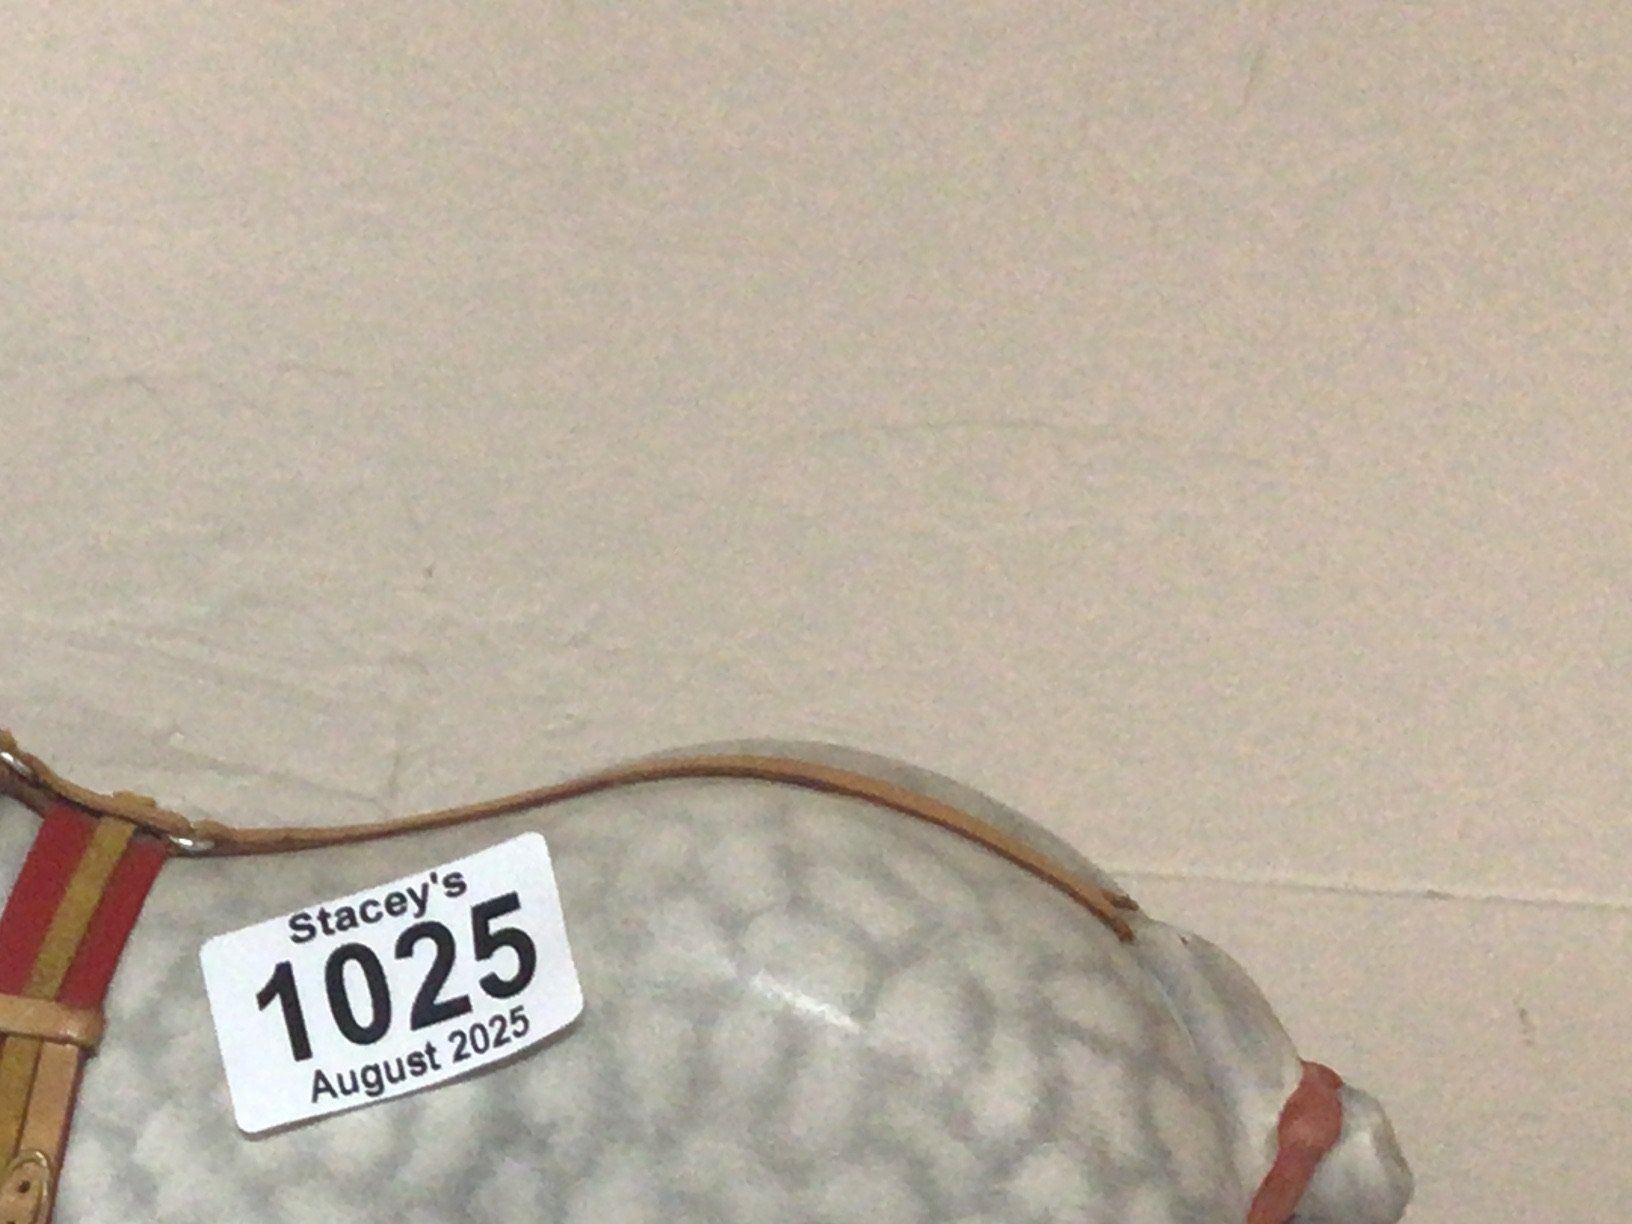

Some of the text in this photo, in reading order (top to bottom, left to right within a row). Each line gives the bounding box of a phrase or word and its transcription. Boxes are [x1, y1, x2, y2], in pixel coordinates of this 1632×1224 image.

[288, 871, 467, 944] Stacey's
[255, 891, 537, 1062] 1025
[311, 1005, 530, 1103] August 2025
